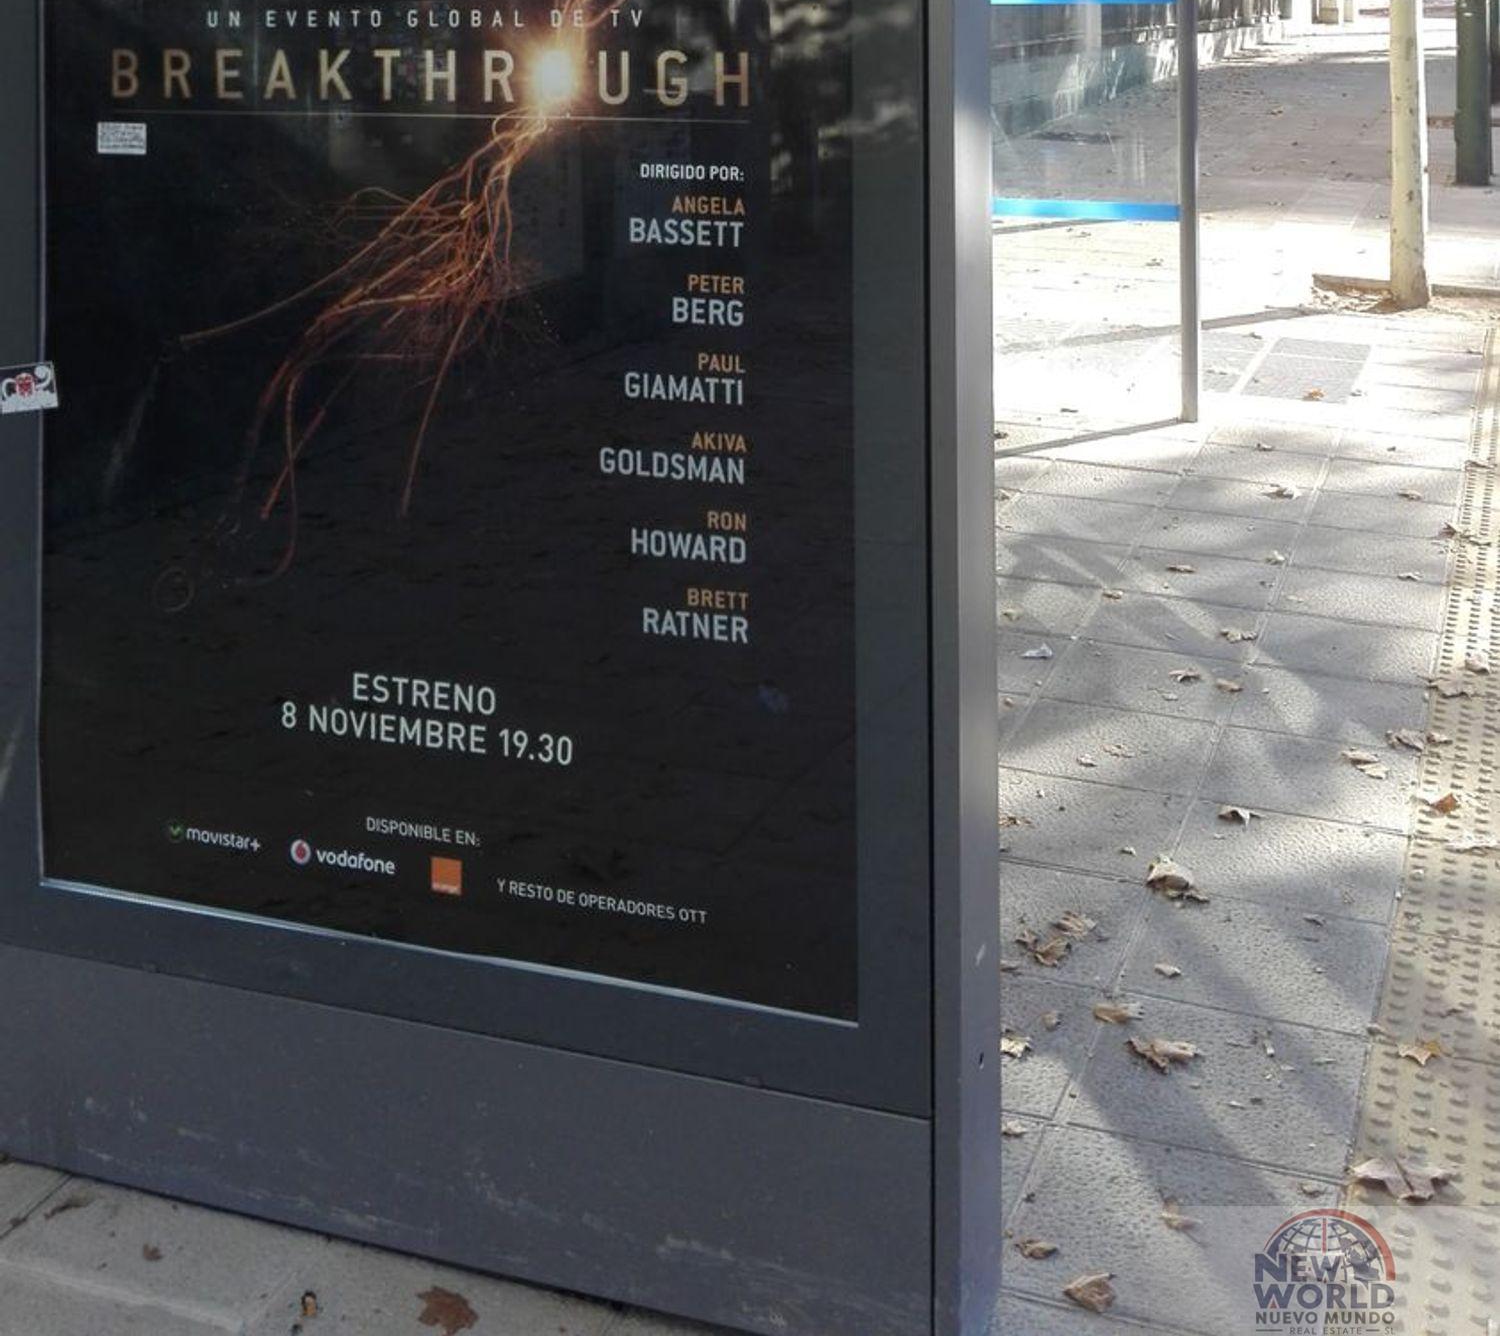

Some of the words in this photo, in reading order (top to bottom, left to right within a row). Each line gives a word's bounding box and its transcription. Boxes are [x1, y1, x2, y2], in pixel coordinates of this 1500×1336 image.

[207, 10, 241, 28] UN
[265, 10, 382, 28] EVENTO
[407, 10, 525, 28] GLOBAL
[551, 10, 584, 28] DE
[611, 10, 643, 28] TV
[111, 48, 749, 106] BREAKTHRUGH
[640, 163, 705, 179] DIRIGIDO
[709, 165, 745, 181] POR:
[672, 196, 745, 215] ANGELA
[629, 217, 744, 247] BASSETT
[687, 273, 744, 294] PETER
[672, 297, 744, 326] BERG
[698, 352, 746, 373] PAUL
[624, 371, 743, 405] GIAMATTI
[691, 431, 747, 453] AKIVA
[600, 447, 745, 485] GOLDSMAN
[707, 510, 747, 532] RON
[631, 527, 746, 564] HOWARD
[687, 587, 749, 610] BRETT
[642, 607, 748, 644] RATNER
[352, 672, 496, 715] ESTRENO
[281, 701, 297, 728] 8
[309, 704, 487, 754] NOVIEMBRE
[499, 728, 573, 765] 19.30
[186, 827, 261, 852] movistar+
[366, 816, 450, 843] DISPONIBLE
[456, 830, 480, 848] EN:
[316, 848, 396, 875] vodafone
[497, 878, 506, 893] Y
[509, 881, 554, 902] RESTO
[556, 888, 576, 905] DE
[578, 893, 675, 920] OPERADORES
[678, 909, 707, 924] OTT
